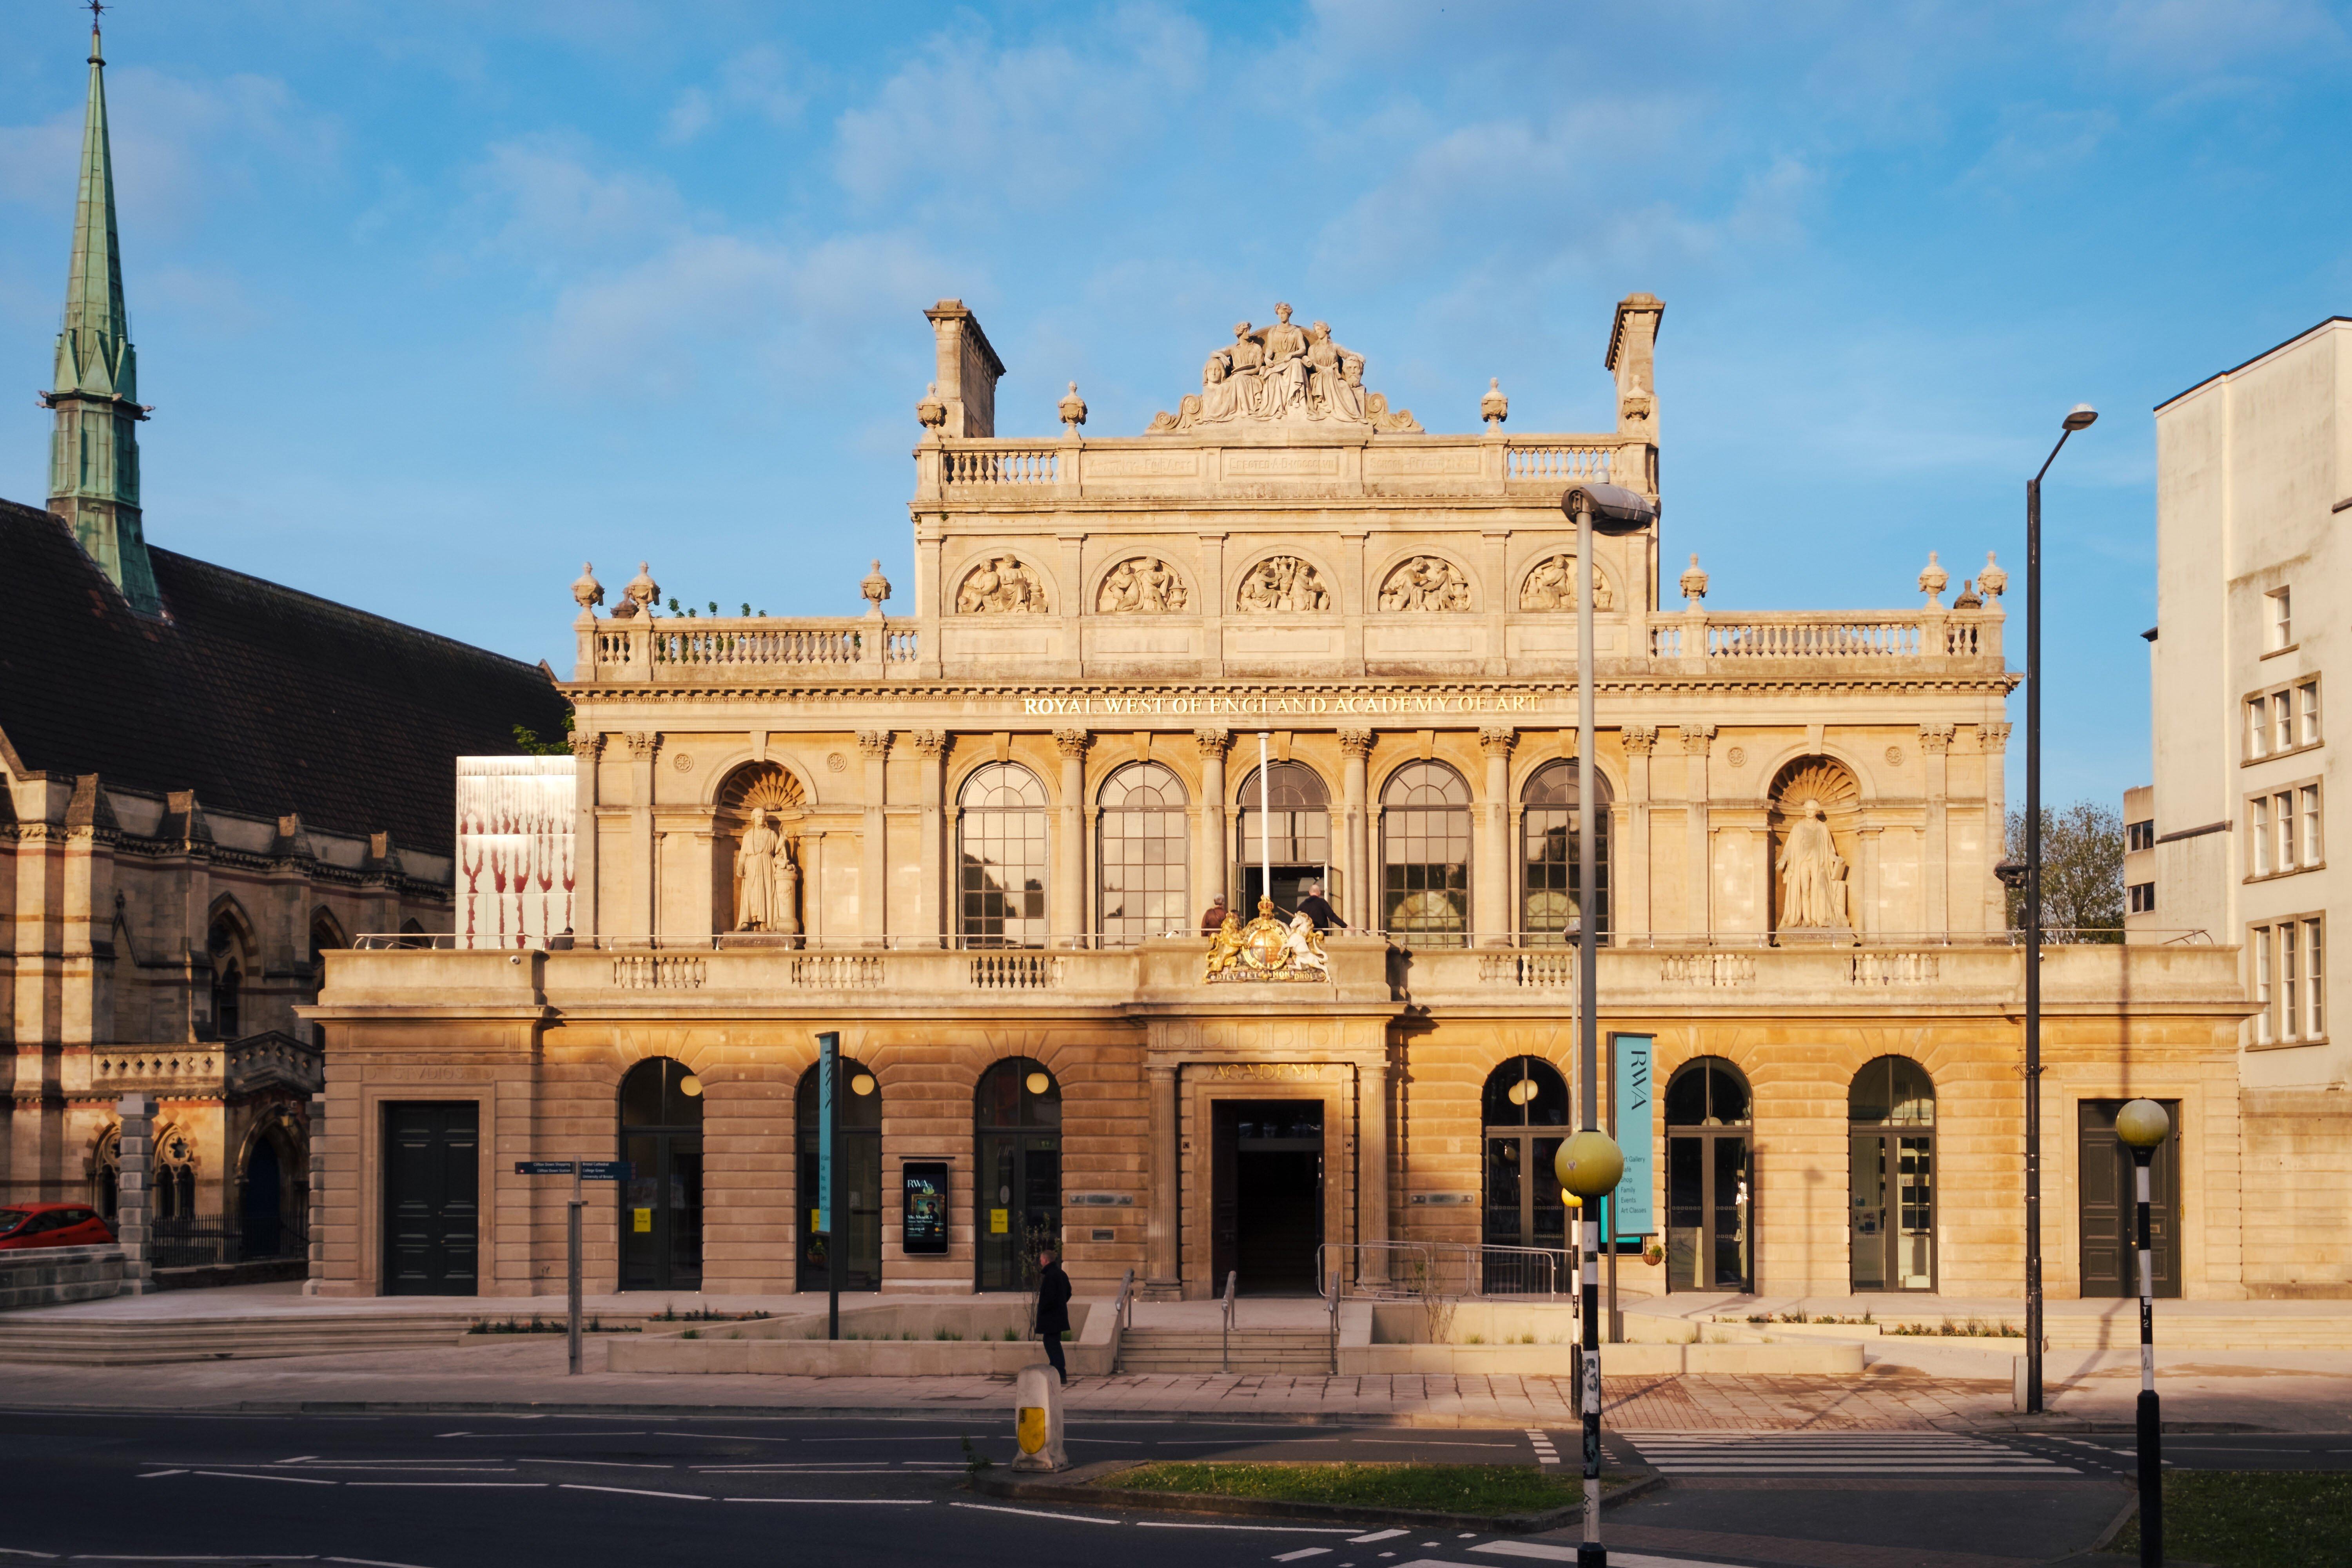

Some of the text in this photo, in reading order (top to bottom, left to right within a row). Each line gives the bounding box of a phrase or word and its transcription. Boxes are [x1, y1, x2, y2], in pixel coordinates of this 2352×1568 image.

[1024, 695, 1541, 714] ROYAL WEST OF ENGLAND ACADEMY OF ART
[1210, 1063, 1325, 1080] ACADEMY
[1631, 1050, 1647, 1110] RWA
[907, 1180, 928, 1188] RWA
